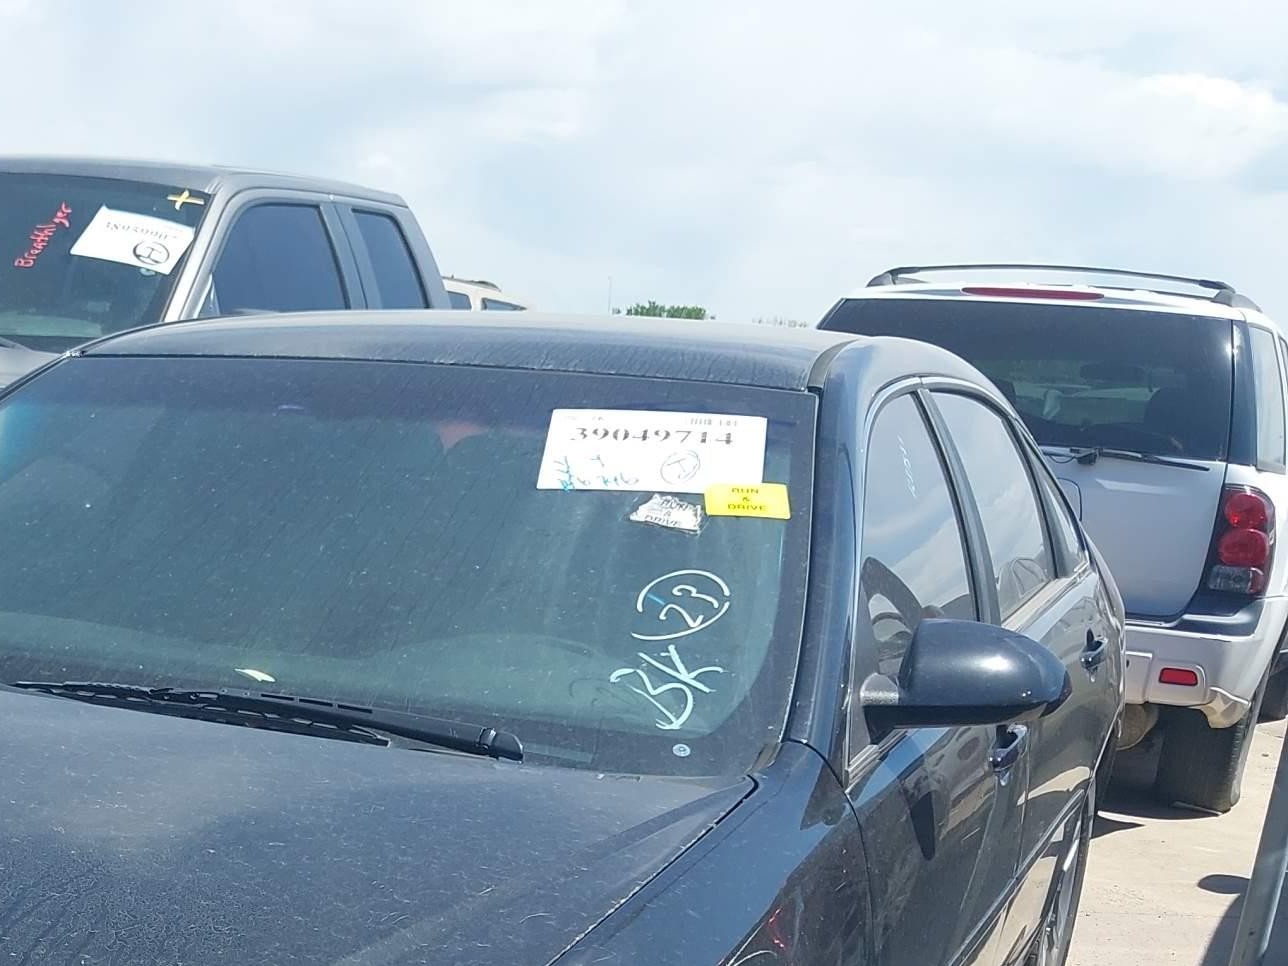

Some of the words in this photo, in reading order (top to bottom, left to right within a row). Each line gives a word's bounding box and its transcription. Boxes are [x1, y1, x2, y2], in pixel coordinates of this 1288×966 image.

[569, 426, 735, 447] 39049714
[731, 487, 760, 495] RUN
[727, 503, 767, 512] DRIVE
[658, 584, 720, 628] 23
